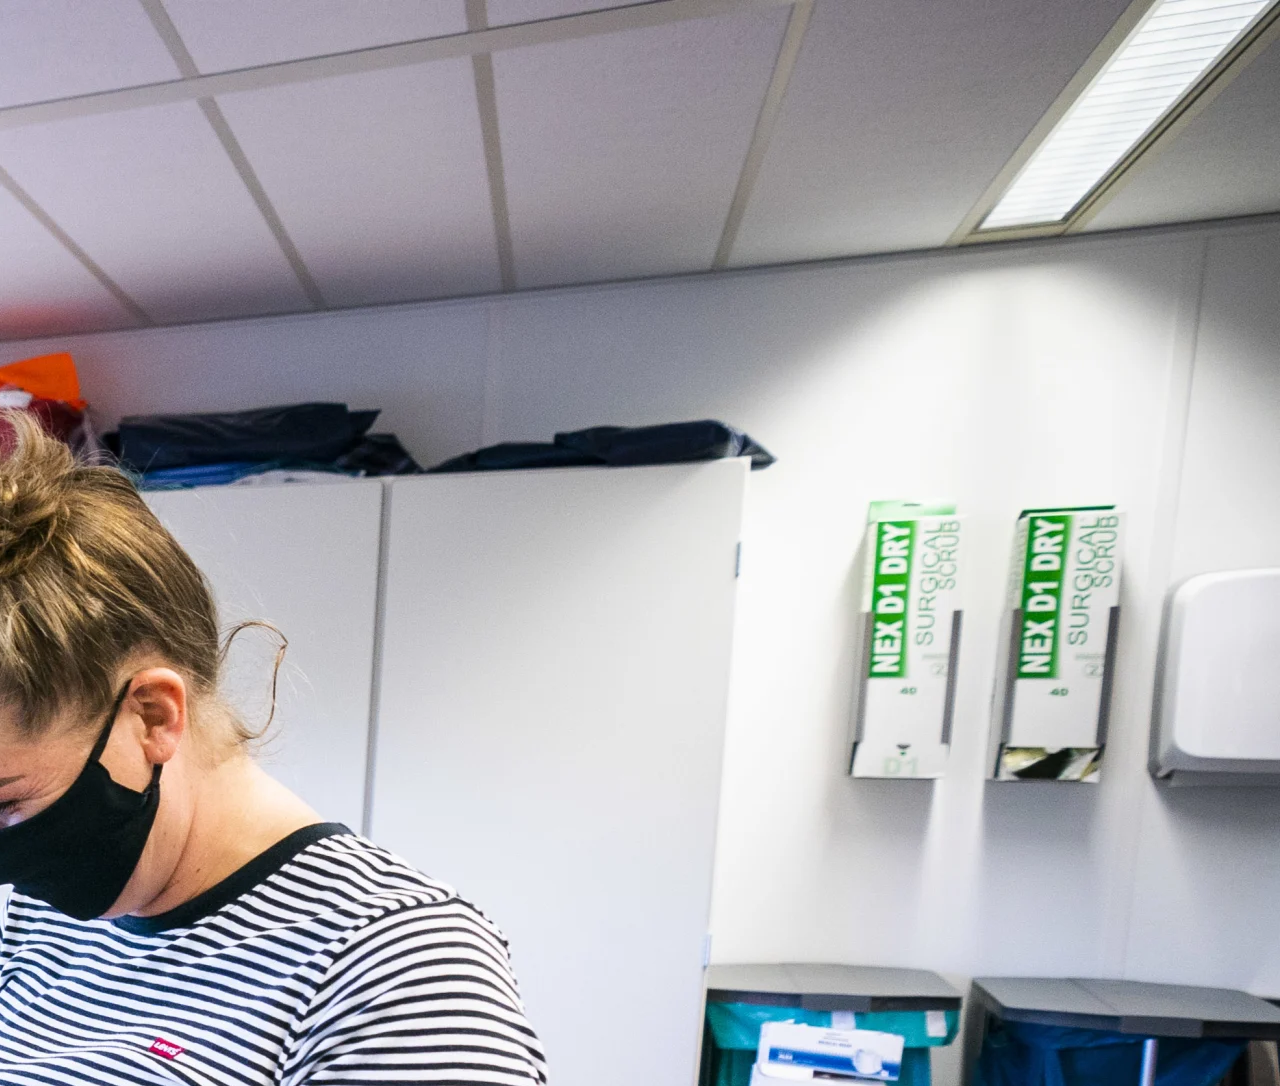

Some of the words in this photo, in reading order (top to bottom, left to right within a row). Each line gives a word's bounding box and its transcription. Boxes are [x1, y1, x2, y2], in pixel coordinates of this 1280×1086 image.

[879, 523, 911, 576] DRY
[939, 519, 961, 590] SCRUB
[1031, 518, 1065, 572] DRY
[1093, 514, 1120, 588] SCRUB
[877, 583, 907, 614] D1
[916, 522, 943, 646] SURGICAL
[1027, 580, 1059, 613] D1
[1067, 516, 1100, 646] SURGICAL
[871, 619, 904, 674] NEX
[1021, 619, 1055, 674] NEX
